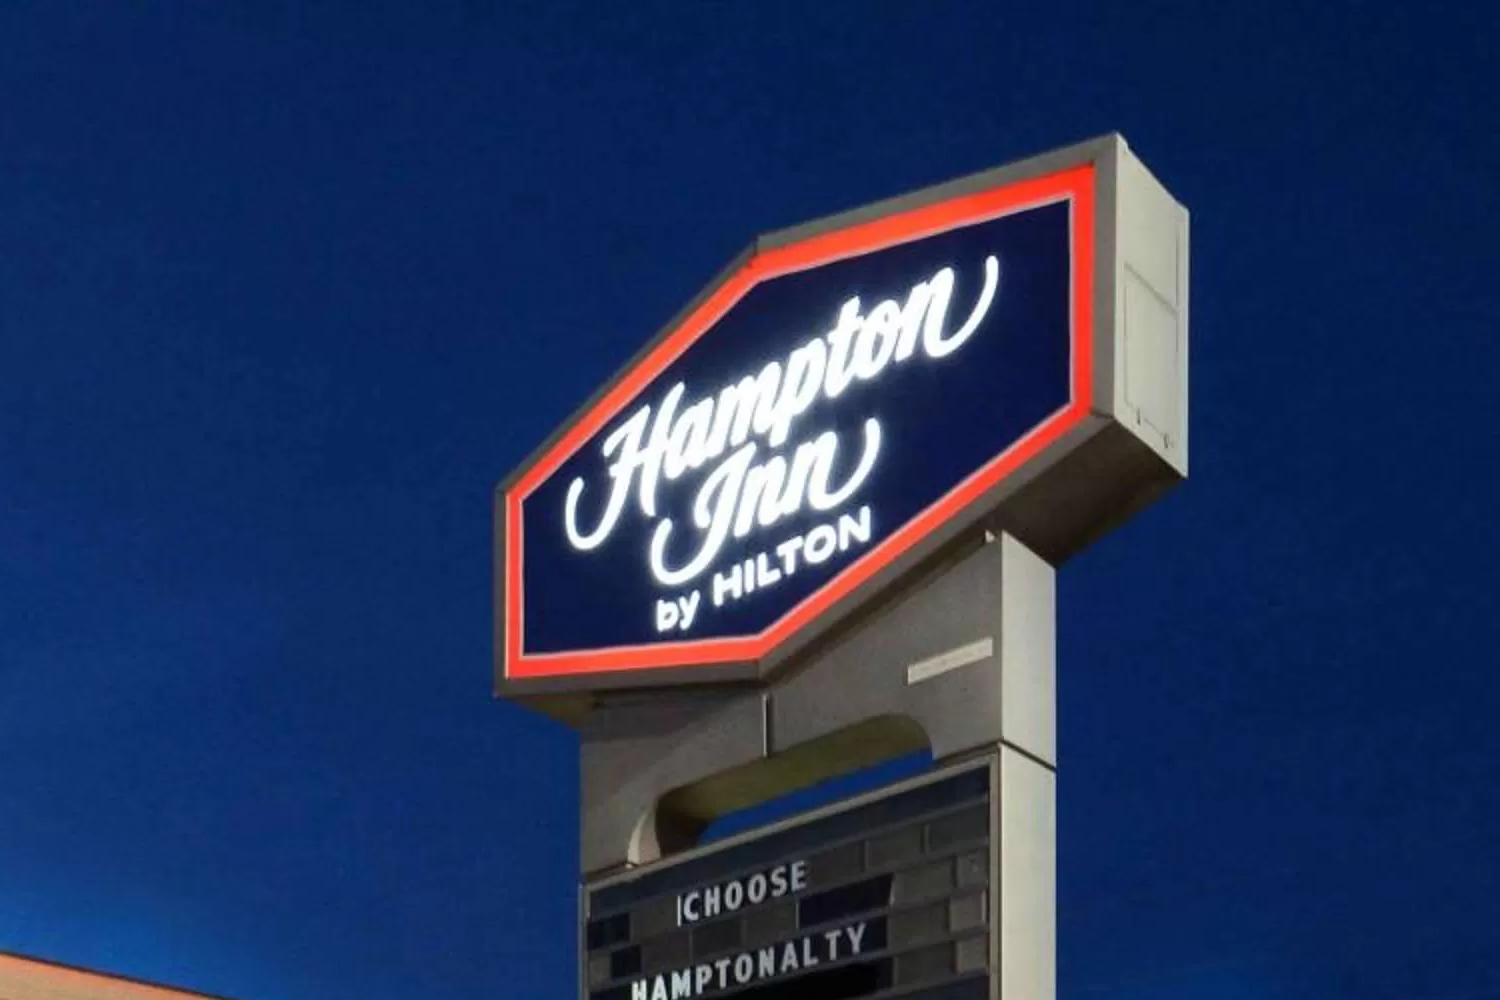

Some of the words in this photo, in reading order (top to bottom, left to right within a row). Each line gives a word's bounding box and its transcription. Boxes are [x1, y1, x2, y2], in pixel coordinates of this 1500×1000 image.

[565, 255, 999, 551] Hampton
[650, 417, 881, 584] Inn
[656, 589, 701, 631] by
[712, 506, 872, 605] HILTON
[682, 860, 809, 922] CHOOSE
